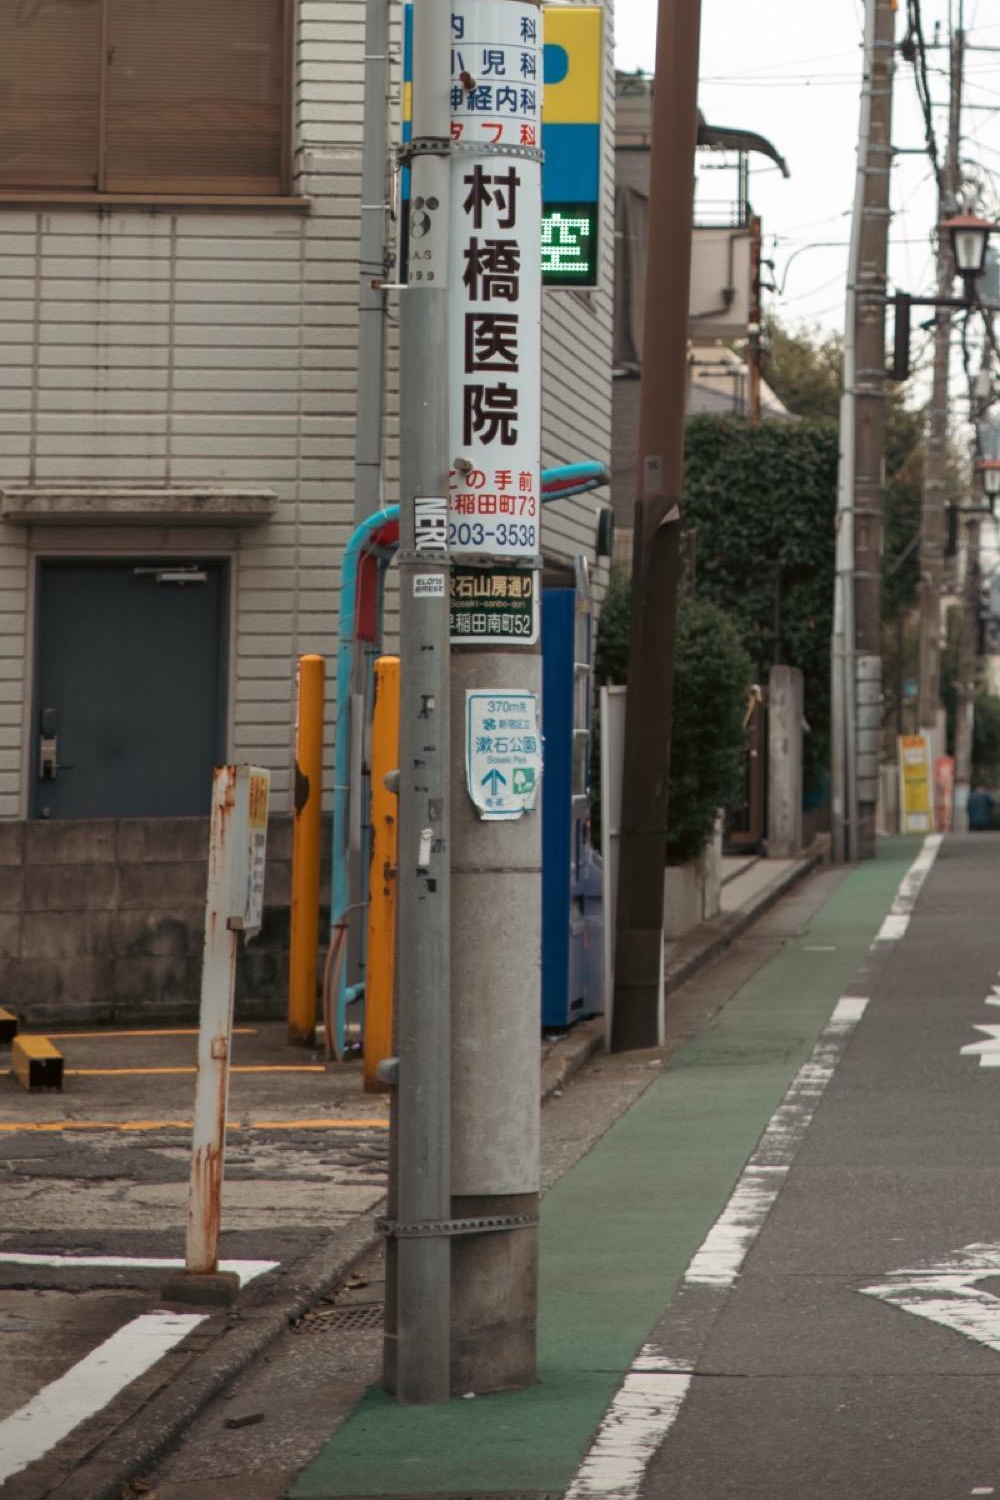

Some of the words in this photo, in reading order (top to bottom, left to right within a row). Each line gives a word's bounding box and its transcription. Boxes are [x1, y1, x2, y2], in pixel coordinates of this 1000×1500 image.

[462, 164, 521, 447] 村橋医院
[448, 494, 536, 517] 稲田町73
[476, 736, 537, 754] 漱石公園
